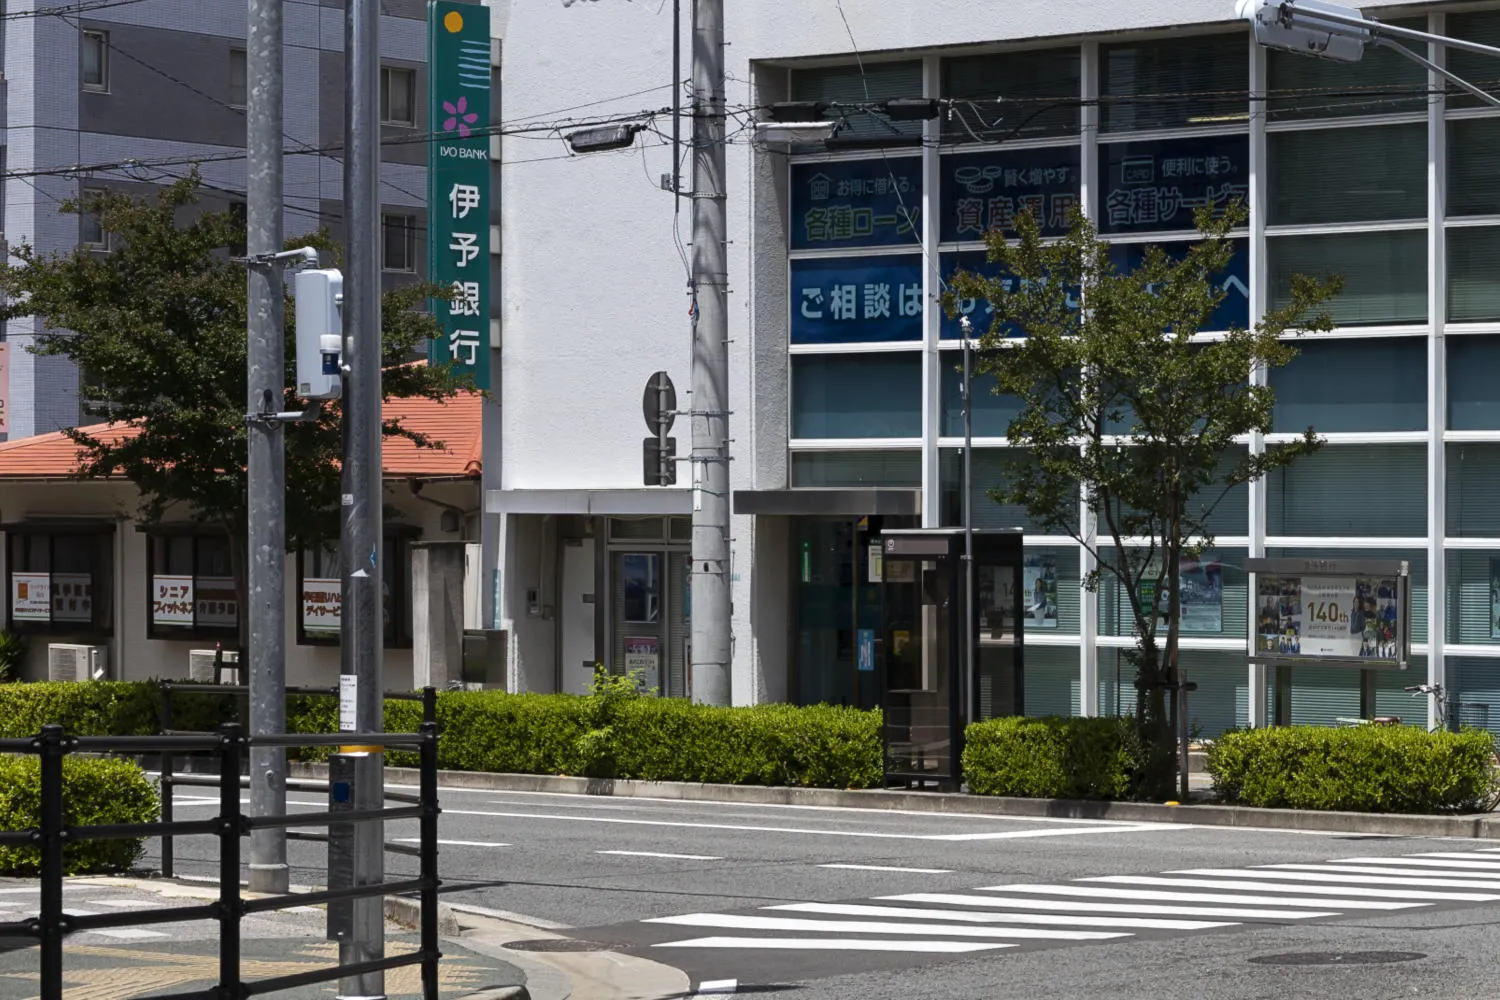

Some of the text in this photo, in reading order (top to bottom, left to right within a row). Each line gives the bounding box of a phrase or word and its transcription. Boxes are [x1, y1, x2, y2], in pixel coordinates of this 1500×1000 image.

[440, 146, 488, 160] IYO BANK
[804, 204, 921, 242] 各種ローン
[448, 183, 480, 366] 伊予銀行
[160, 585, 189, 599] シニア
